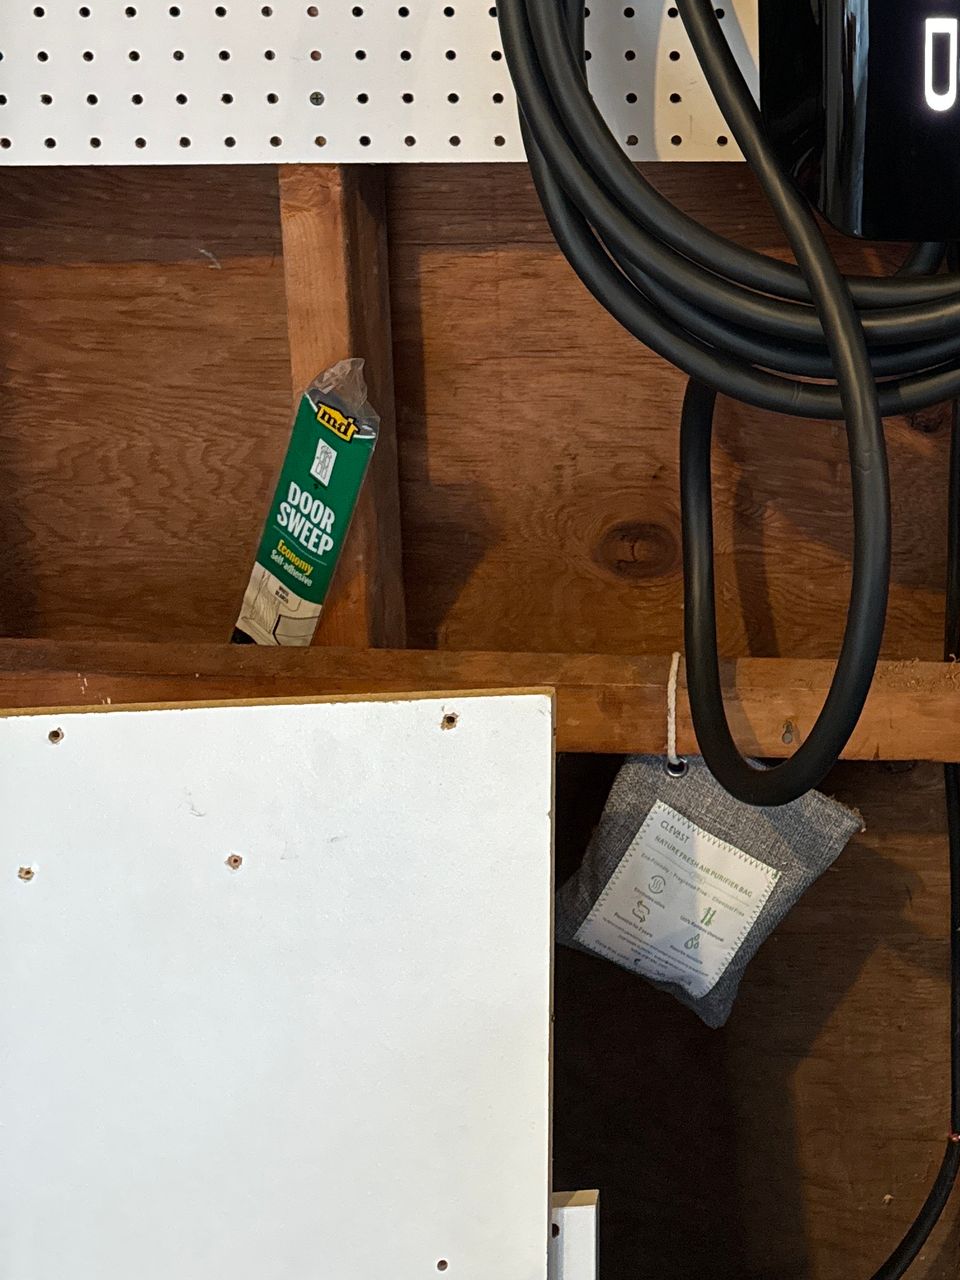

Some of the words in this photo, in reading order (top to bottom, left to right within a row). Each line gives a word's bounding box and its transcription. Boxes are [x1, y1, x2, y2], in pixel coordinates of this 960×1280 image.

[277, 502, 334, 556] SWEEP
[287, 481, 335, 533] DOOR
[270, 549, 313, 587] Self-adhesive
[277, 539, 314, 577] Economy
[659, 820, 690, 844] CLEVAST
[653, 834, 680, 855] NATURE
[678, 851, 700, 868] FRESH
[698, 863, 711, 874] AIR
[709, 868, 739, 891] PURIFIER
[737, 885, 753, 898] BAG
